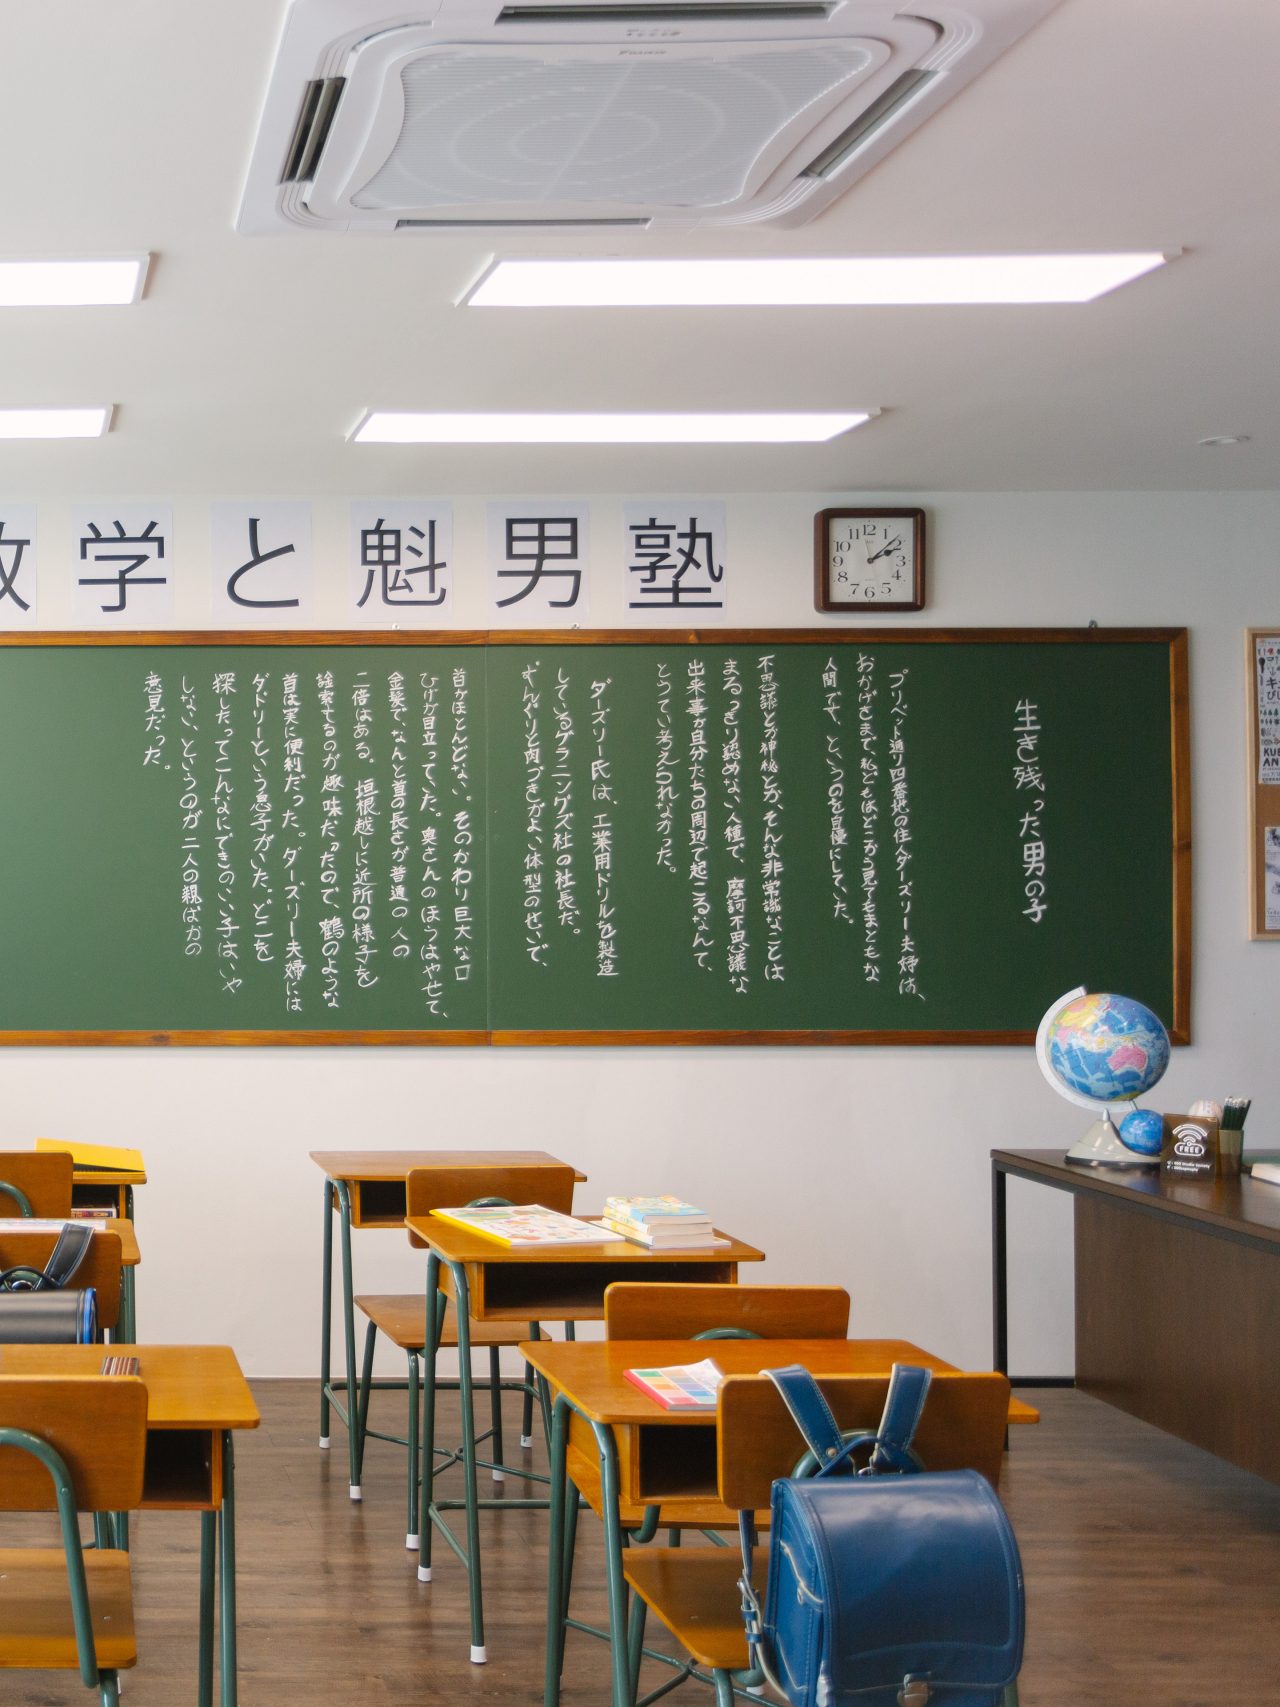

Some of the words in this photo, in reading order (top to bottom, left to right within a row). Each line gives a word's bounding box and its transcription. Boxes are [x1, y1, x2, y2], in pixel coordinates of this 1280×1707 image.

[849, 528, 860, 540] 11
[863, 524, 877, 536] 12
[883, 528, 888, 539] 1
[835, 541, 851, 553] 10
[893, 539, 902, 551] 2
[832, 556, 844, 567] 9
[895, 555, 906, 567] 3
[837, 571, 849, 583] 8
[891, 569, 902, 581] 4
[850, 583, 860, 595] 7
[864, 586, 876, 599] 6
[880, 582, 892, 595] 5
[143, 671, 171, 769] 意見だった。
[388, 672, 410, 957] 金髪で、なんと首の長さが普通の人の
[1013, 698, 1048, 923] 生き残った男の子
[590, 678, 619, 976] ダーズリー氏は、工業用ドリルを製造
[1179, 1145, 1200, 1154] FREE
